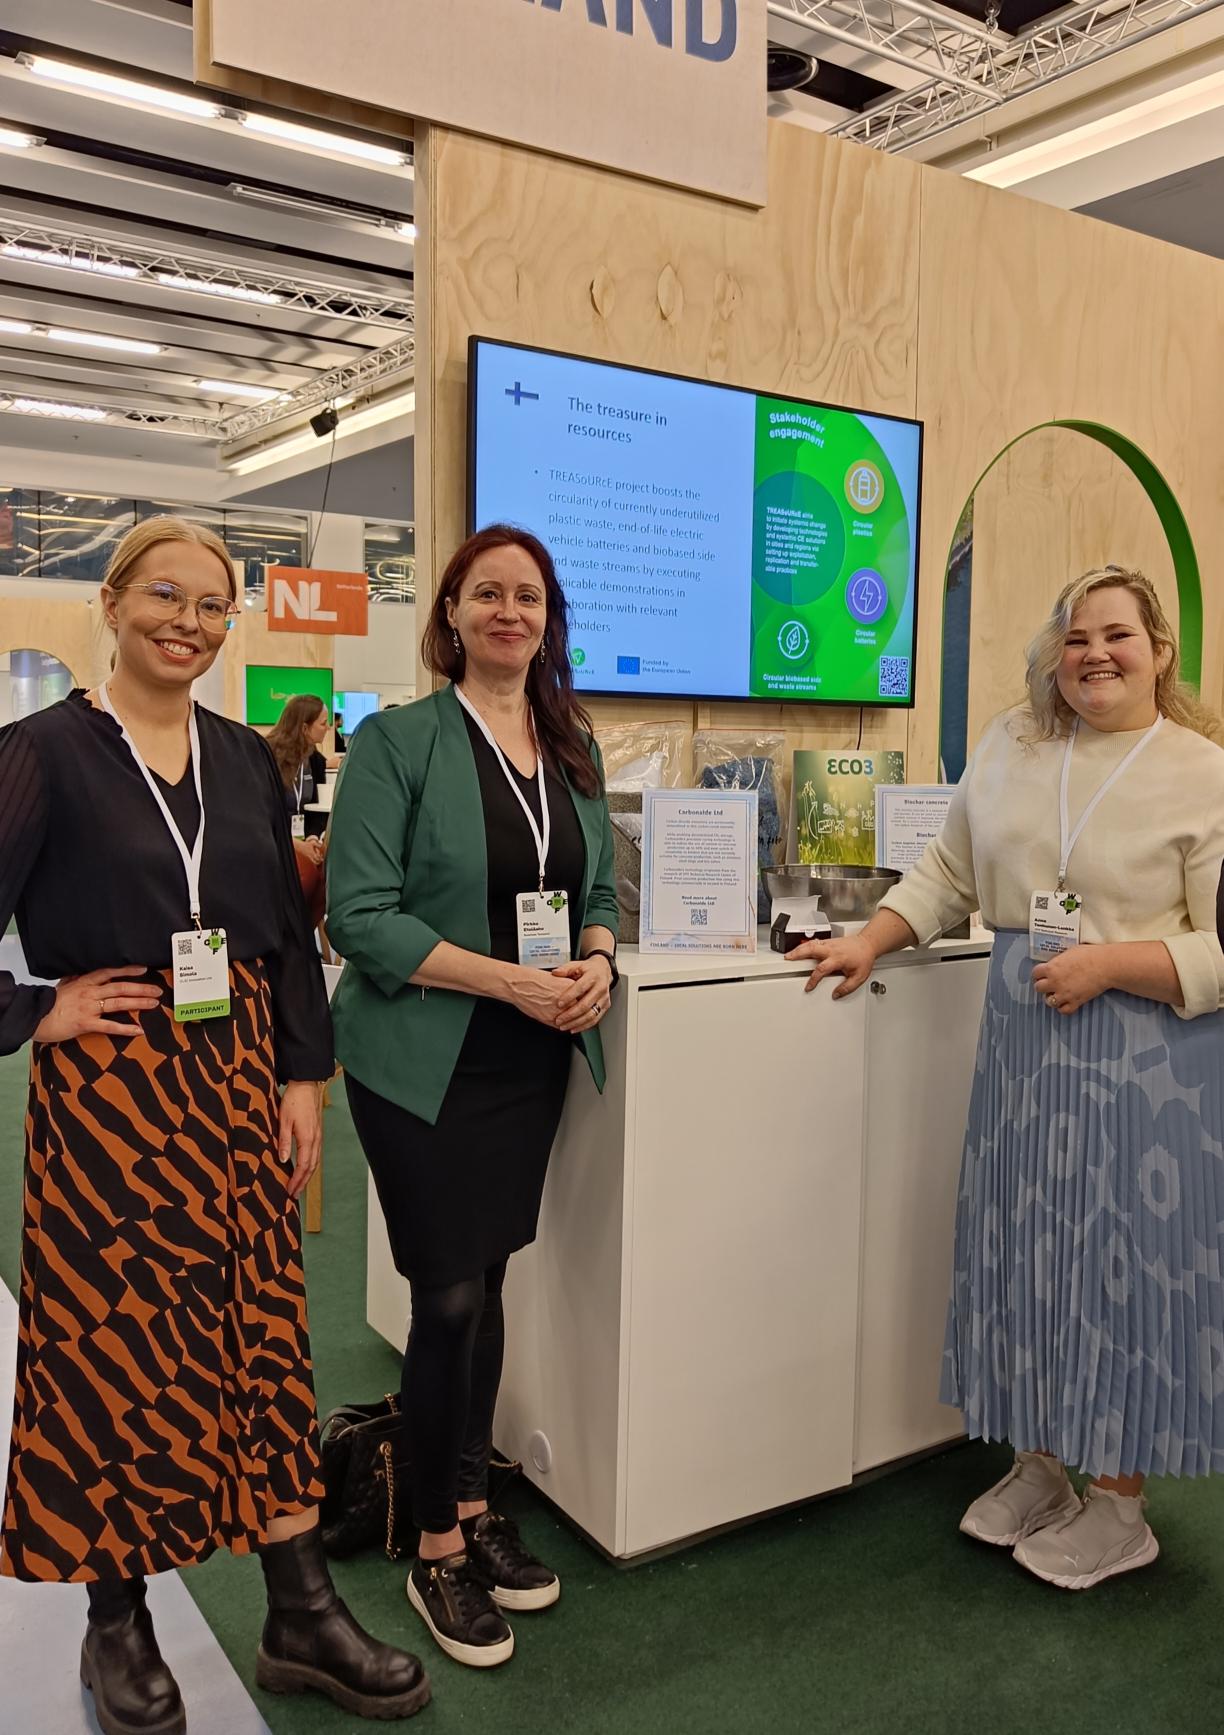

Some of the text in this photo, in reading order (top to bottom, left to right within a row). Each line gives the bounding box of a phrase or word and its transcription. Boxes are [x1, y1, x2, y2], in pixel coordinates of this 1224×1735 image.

[568, 396, 668, 426] The treasure in
[769, 412, 825, 434] Stakeholder
[568, 422, 632, 444] resources
[769, 428, 824, 448] engagement
[549, 468, 700, 501] TREASoURcE project boosts the
[549, 492, 720, 522] circularity of currently underutilized
[548, 513, 704, 542] plastic waste, end-of-life electric
[548, 534, 716, 562] vehicle batteries and biobased side
[554, 556, 701, 582] nd waste streams by executing
[559, 577, 686, 598] plicable demonstrations in
[274, 579, 337, 622] NL
[570, 599, 678, 618] boration with relevant
[568, 619, 611, 633] eholders
[181, 1005, 224, 1016] PARTICIPANT
